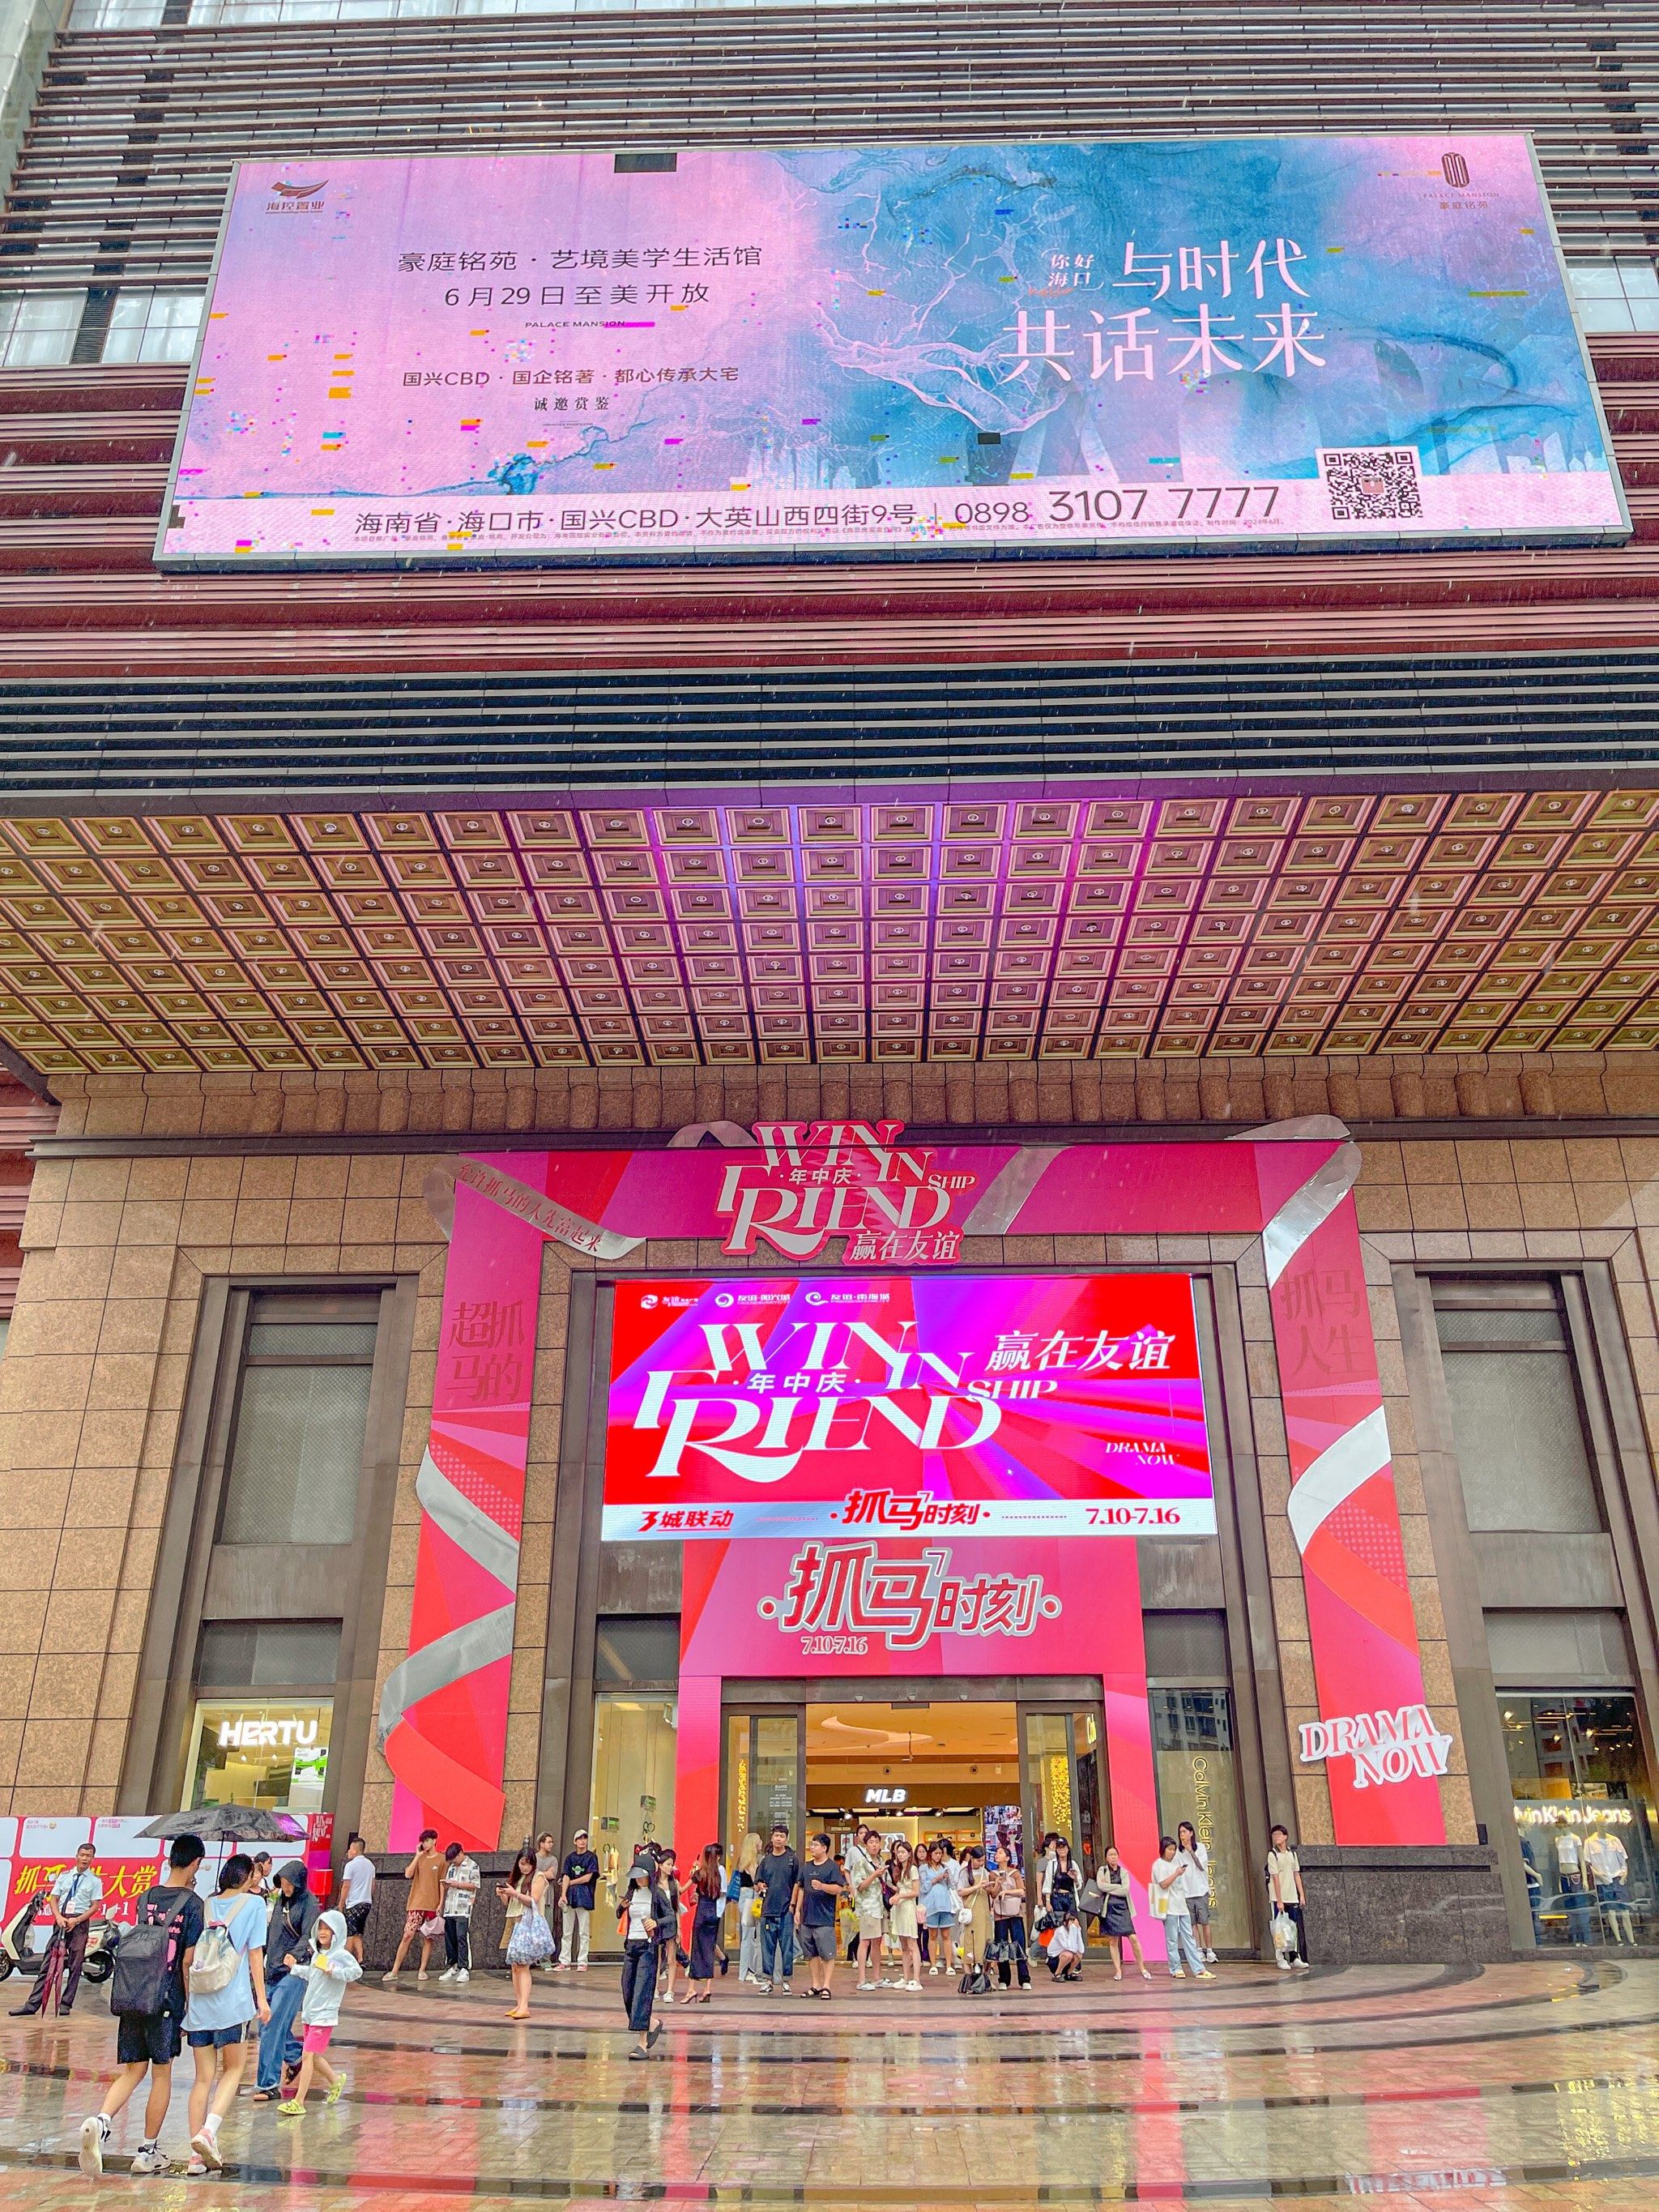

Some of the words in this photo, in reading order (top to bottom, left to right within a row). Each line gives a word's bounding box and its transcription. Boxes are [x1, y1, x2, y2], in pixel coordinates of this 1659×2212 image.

[1111, 237, 1311, 302] 与时代
[998, 302, 1327, 382] 共话未来
[954, 501, 1030, 524] 0898
[1048, 489, 1149, 523] 3107
[1167, 485, 1280, 520] 7777
[787, 1167, 853, 1185] 年中庆
[458, 1163, 603, 1253] 允许抓马的人先富起来
[850, 1229, 962, 1262] 赢在友谊
[983, 1329, 1176, 1372] 赢在友谊
[746, 1373, 847, 1394] 年中庆
[218, 1719, 319, 1748] HERTU
[1298, 1703, 1441, 1763] DRAMA
[1353, 1734, 1454, 1789] NOW
[864, 1787, 907, 1804] MLB
[1192, 1756, 1210, 1813] Calvin
